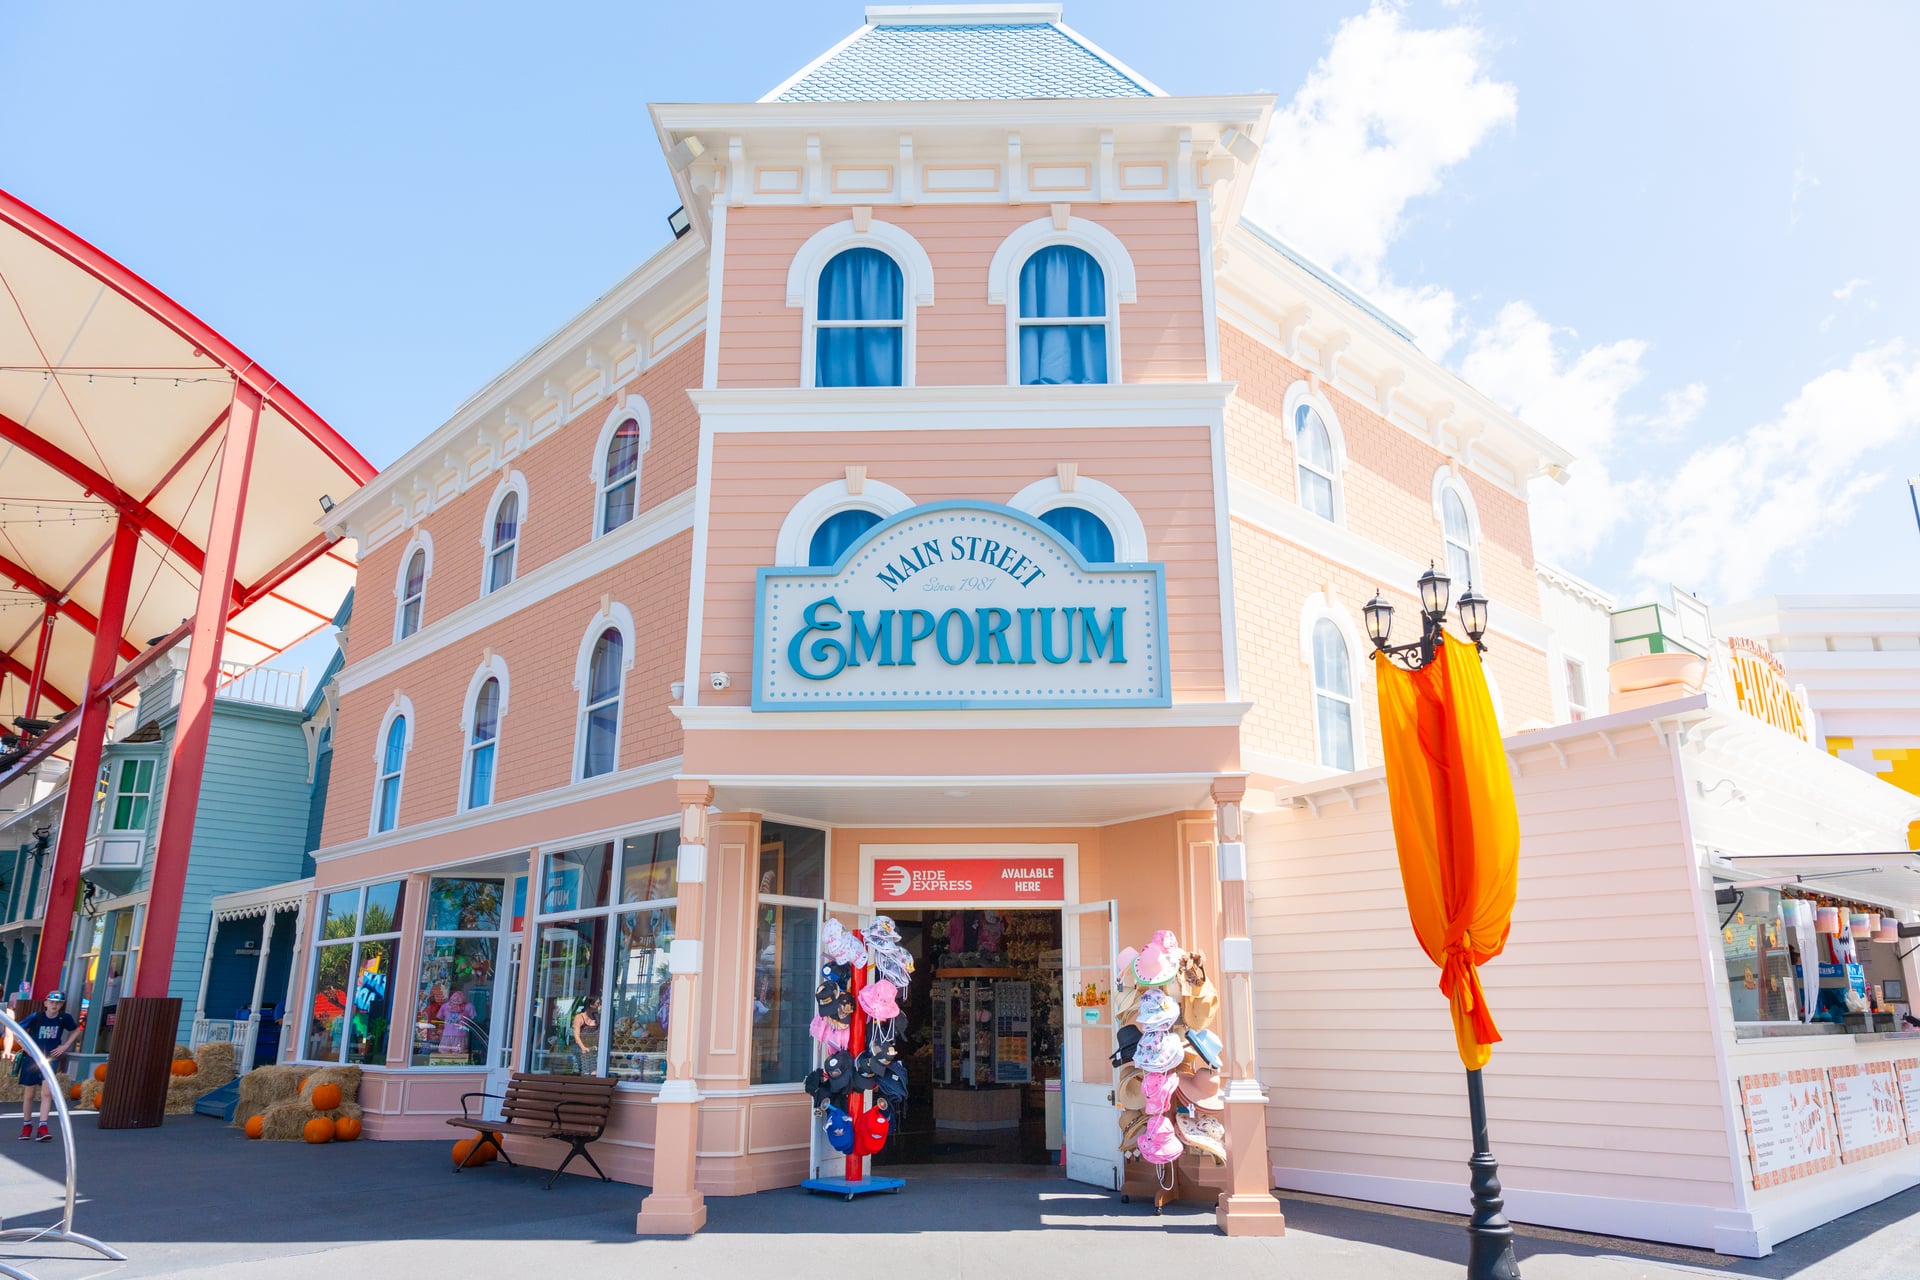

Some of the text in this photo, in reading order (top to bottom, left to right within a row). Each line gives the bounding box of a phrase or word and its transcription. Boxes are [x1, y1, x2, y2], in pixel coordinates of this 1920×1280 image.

[876, 535, 1046, 592] MAIN STREET
[922, 576, 997, 592] Since 1981
[788, 595, 1128, 681] EMPORIUM
[1727, 657, 1808, 743] CHURROS
[912, 870, 946, 881] RIDE
[1001, 868, 1054, 879] AVAILABLE
[912, 880, 973, 891] EXPRESS
[1015, 881, 1041, 892] HERE
